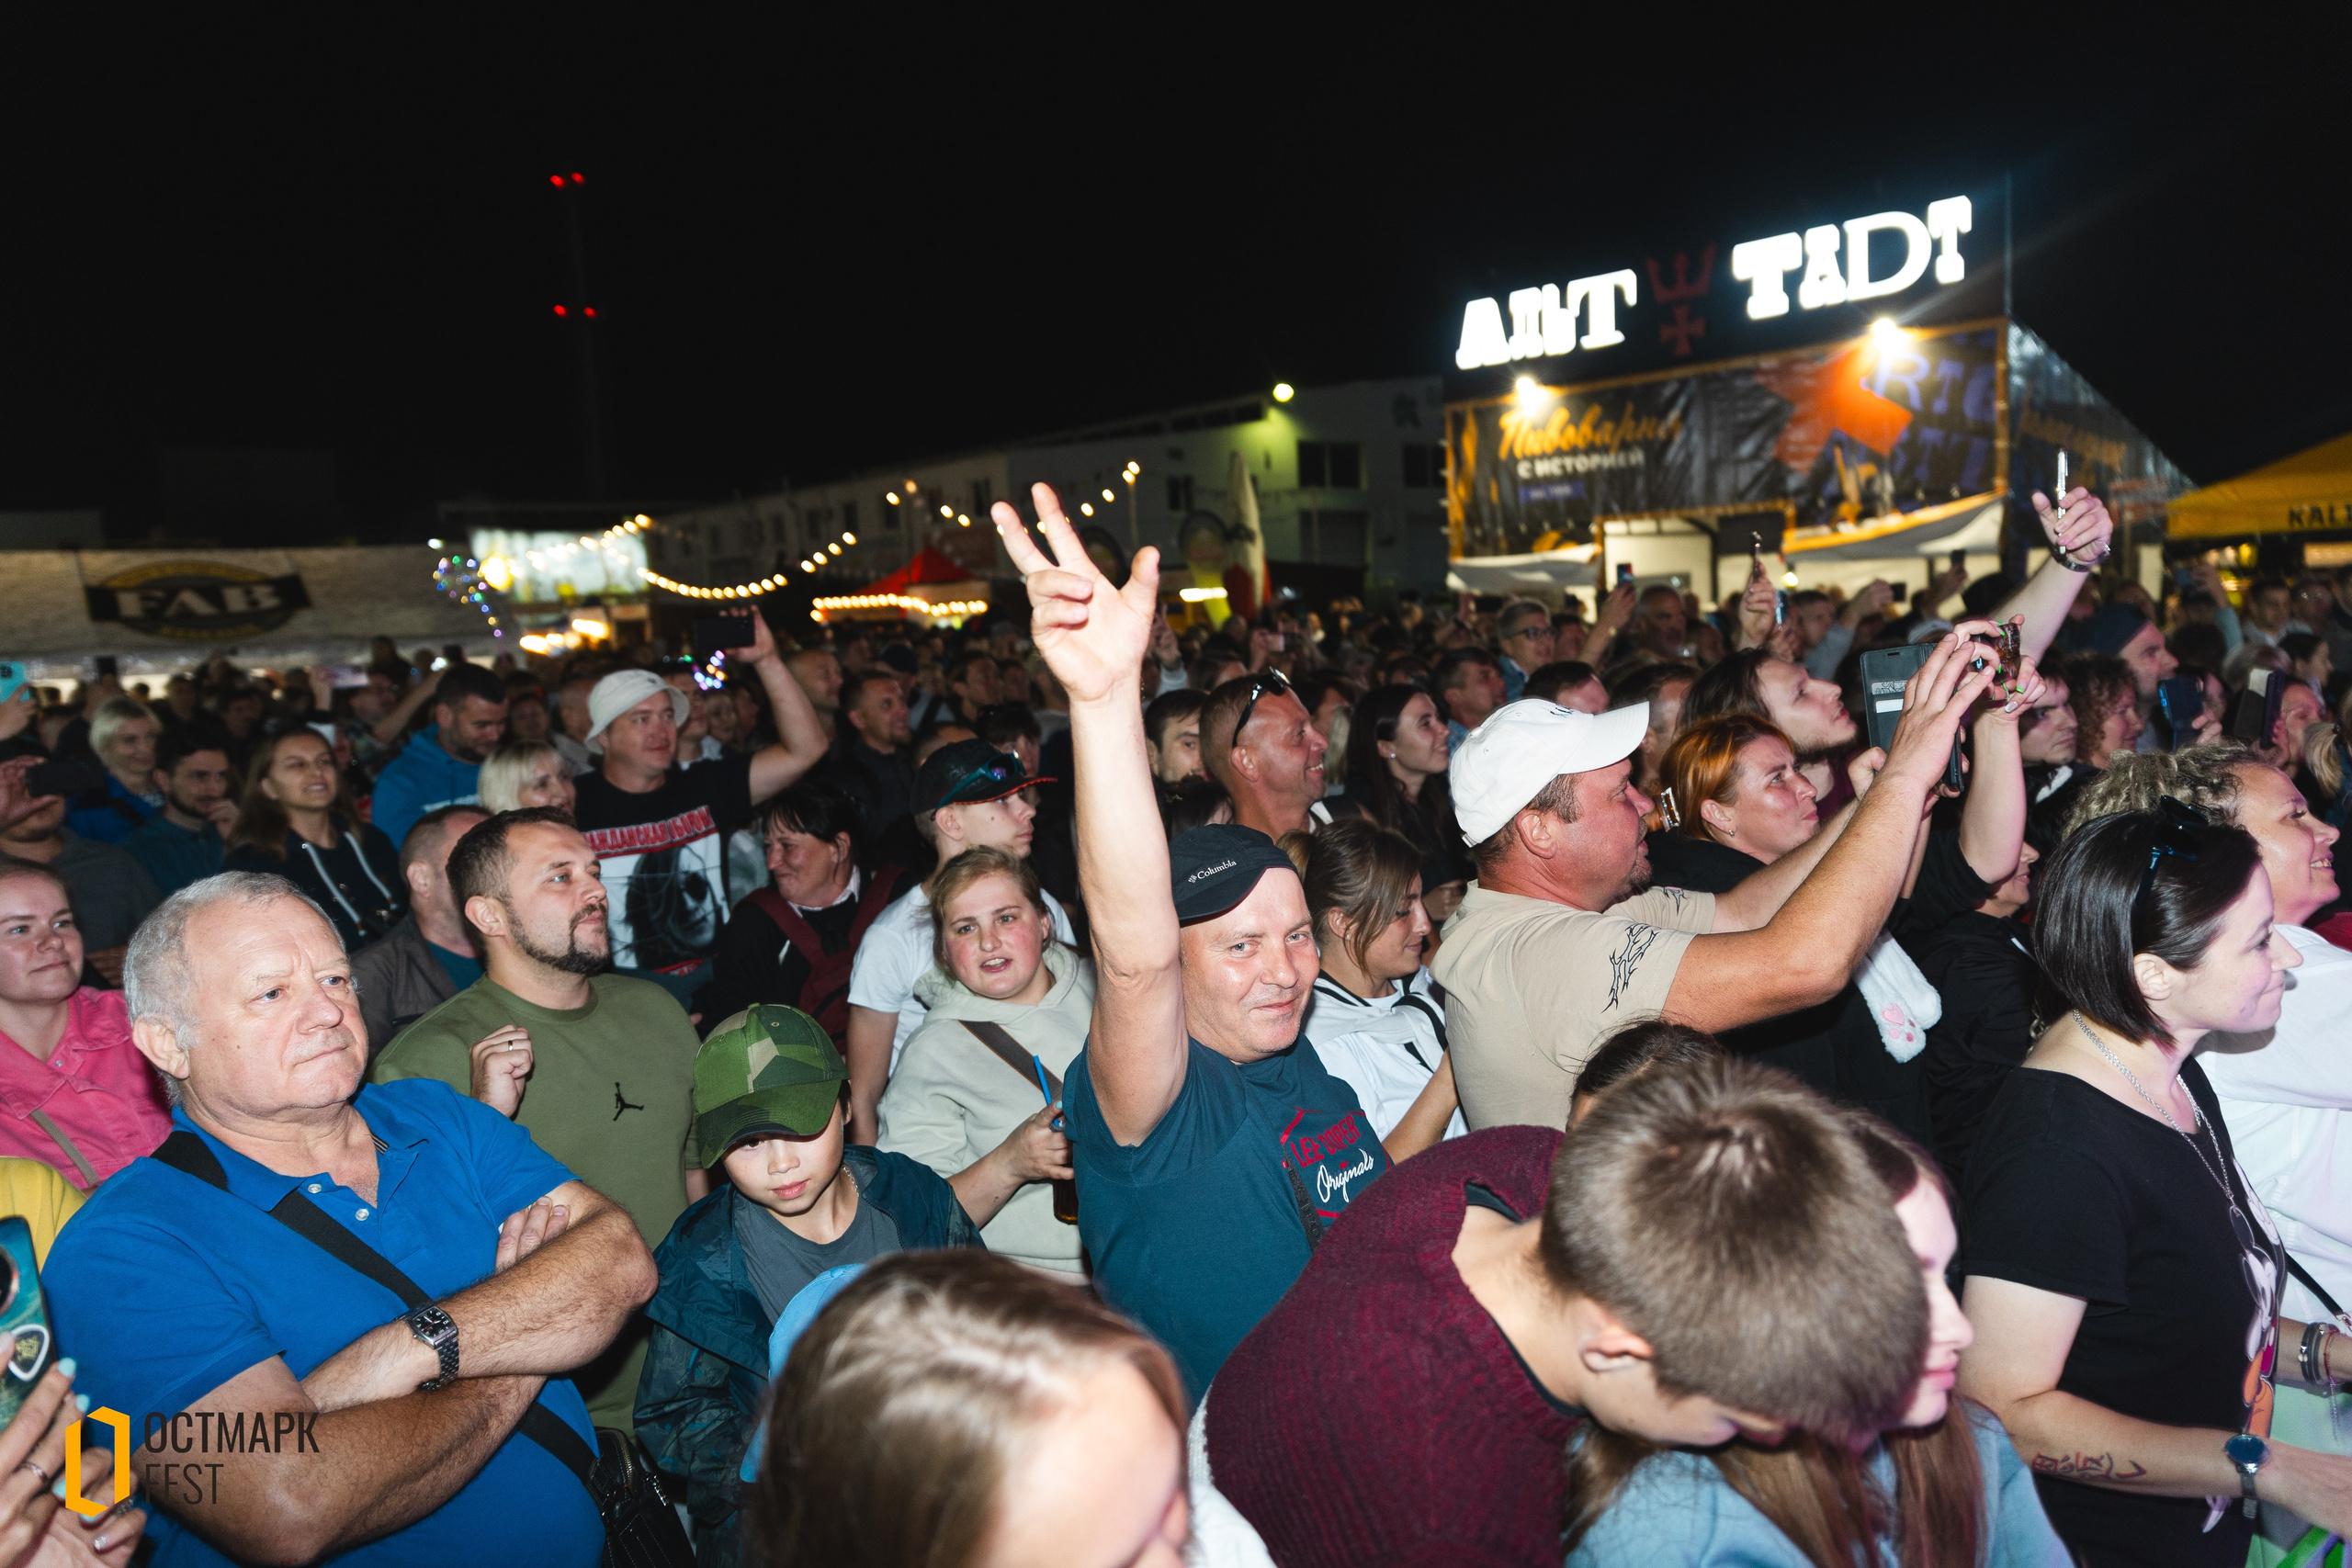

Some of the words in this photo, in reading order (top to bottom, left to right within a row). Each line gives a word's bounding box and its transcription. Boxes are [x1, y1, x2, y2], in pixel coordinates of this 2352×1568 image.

[1197, 860, 1237, 880] Columbia
[1290, 1137, 1325, 1168] LEE
[1317, 1147, 1374, 1203] Originals
